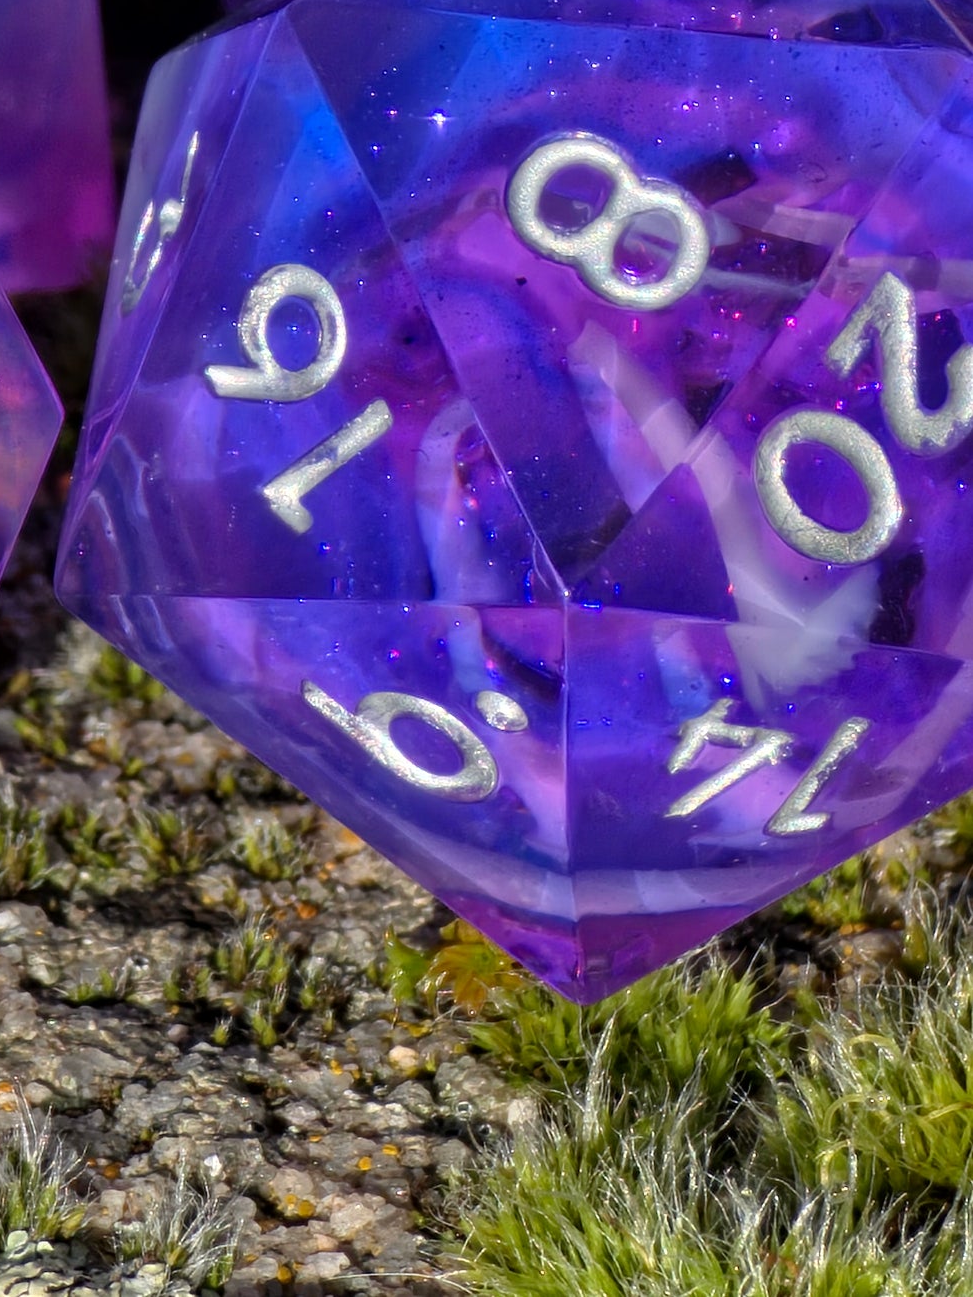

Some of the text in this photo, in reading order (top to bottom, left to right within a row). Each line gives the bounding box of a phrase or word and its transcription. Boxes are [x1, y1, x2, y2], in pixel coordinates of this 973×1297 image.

[506, 130, 710, 310] 8
[753, 272, 973, 564] 20
[666, 699, 871, 837] 14
